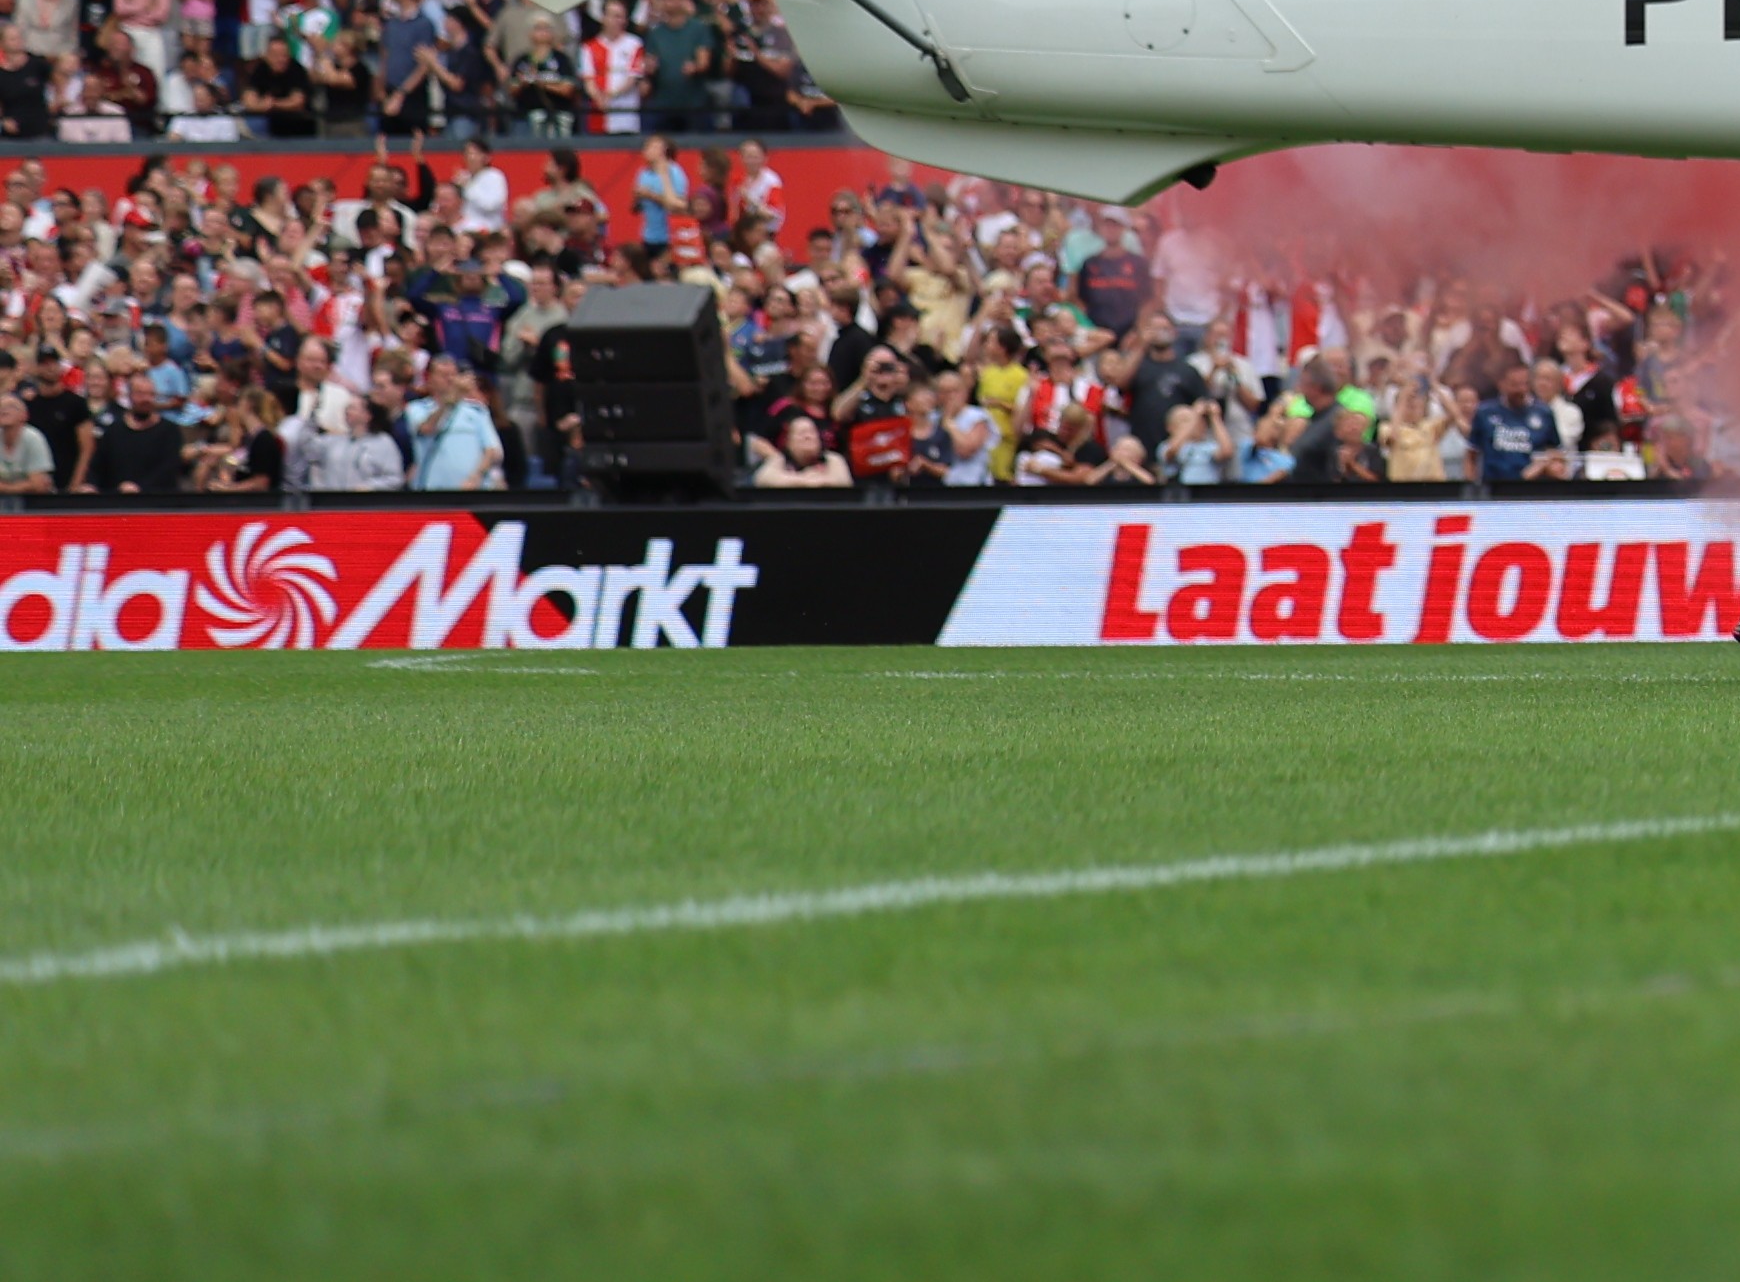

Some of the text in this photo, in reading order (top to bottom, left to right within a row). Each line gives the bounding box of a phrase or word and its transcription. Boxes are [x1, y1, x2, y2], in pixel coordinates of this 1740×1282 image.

[0, 521, 758, 650] dia Markt
[1099, 521, 1396, 643] Laat
